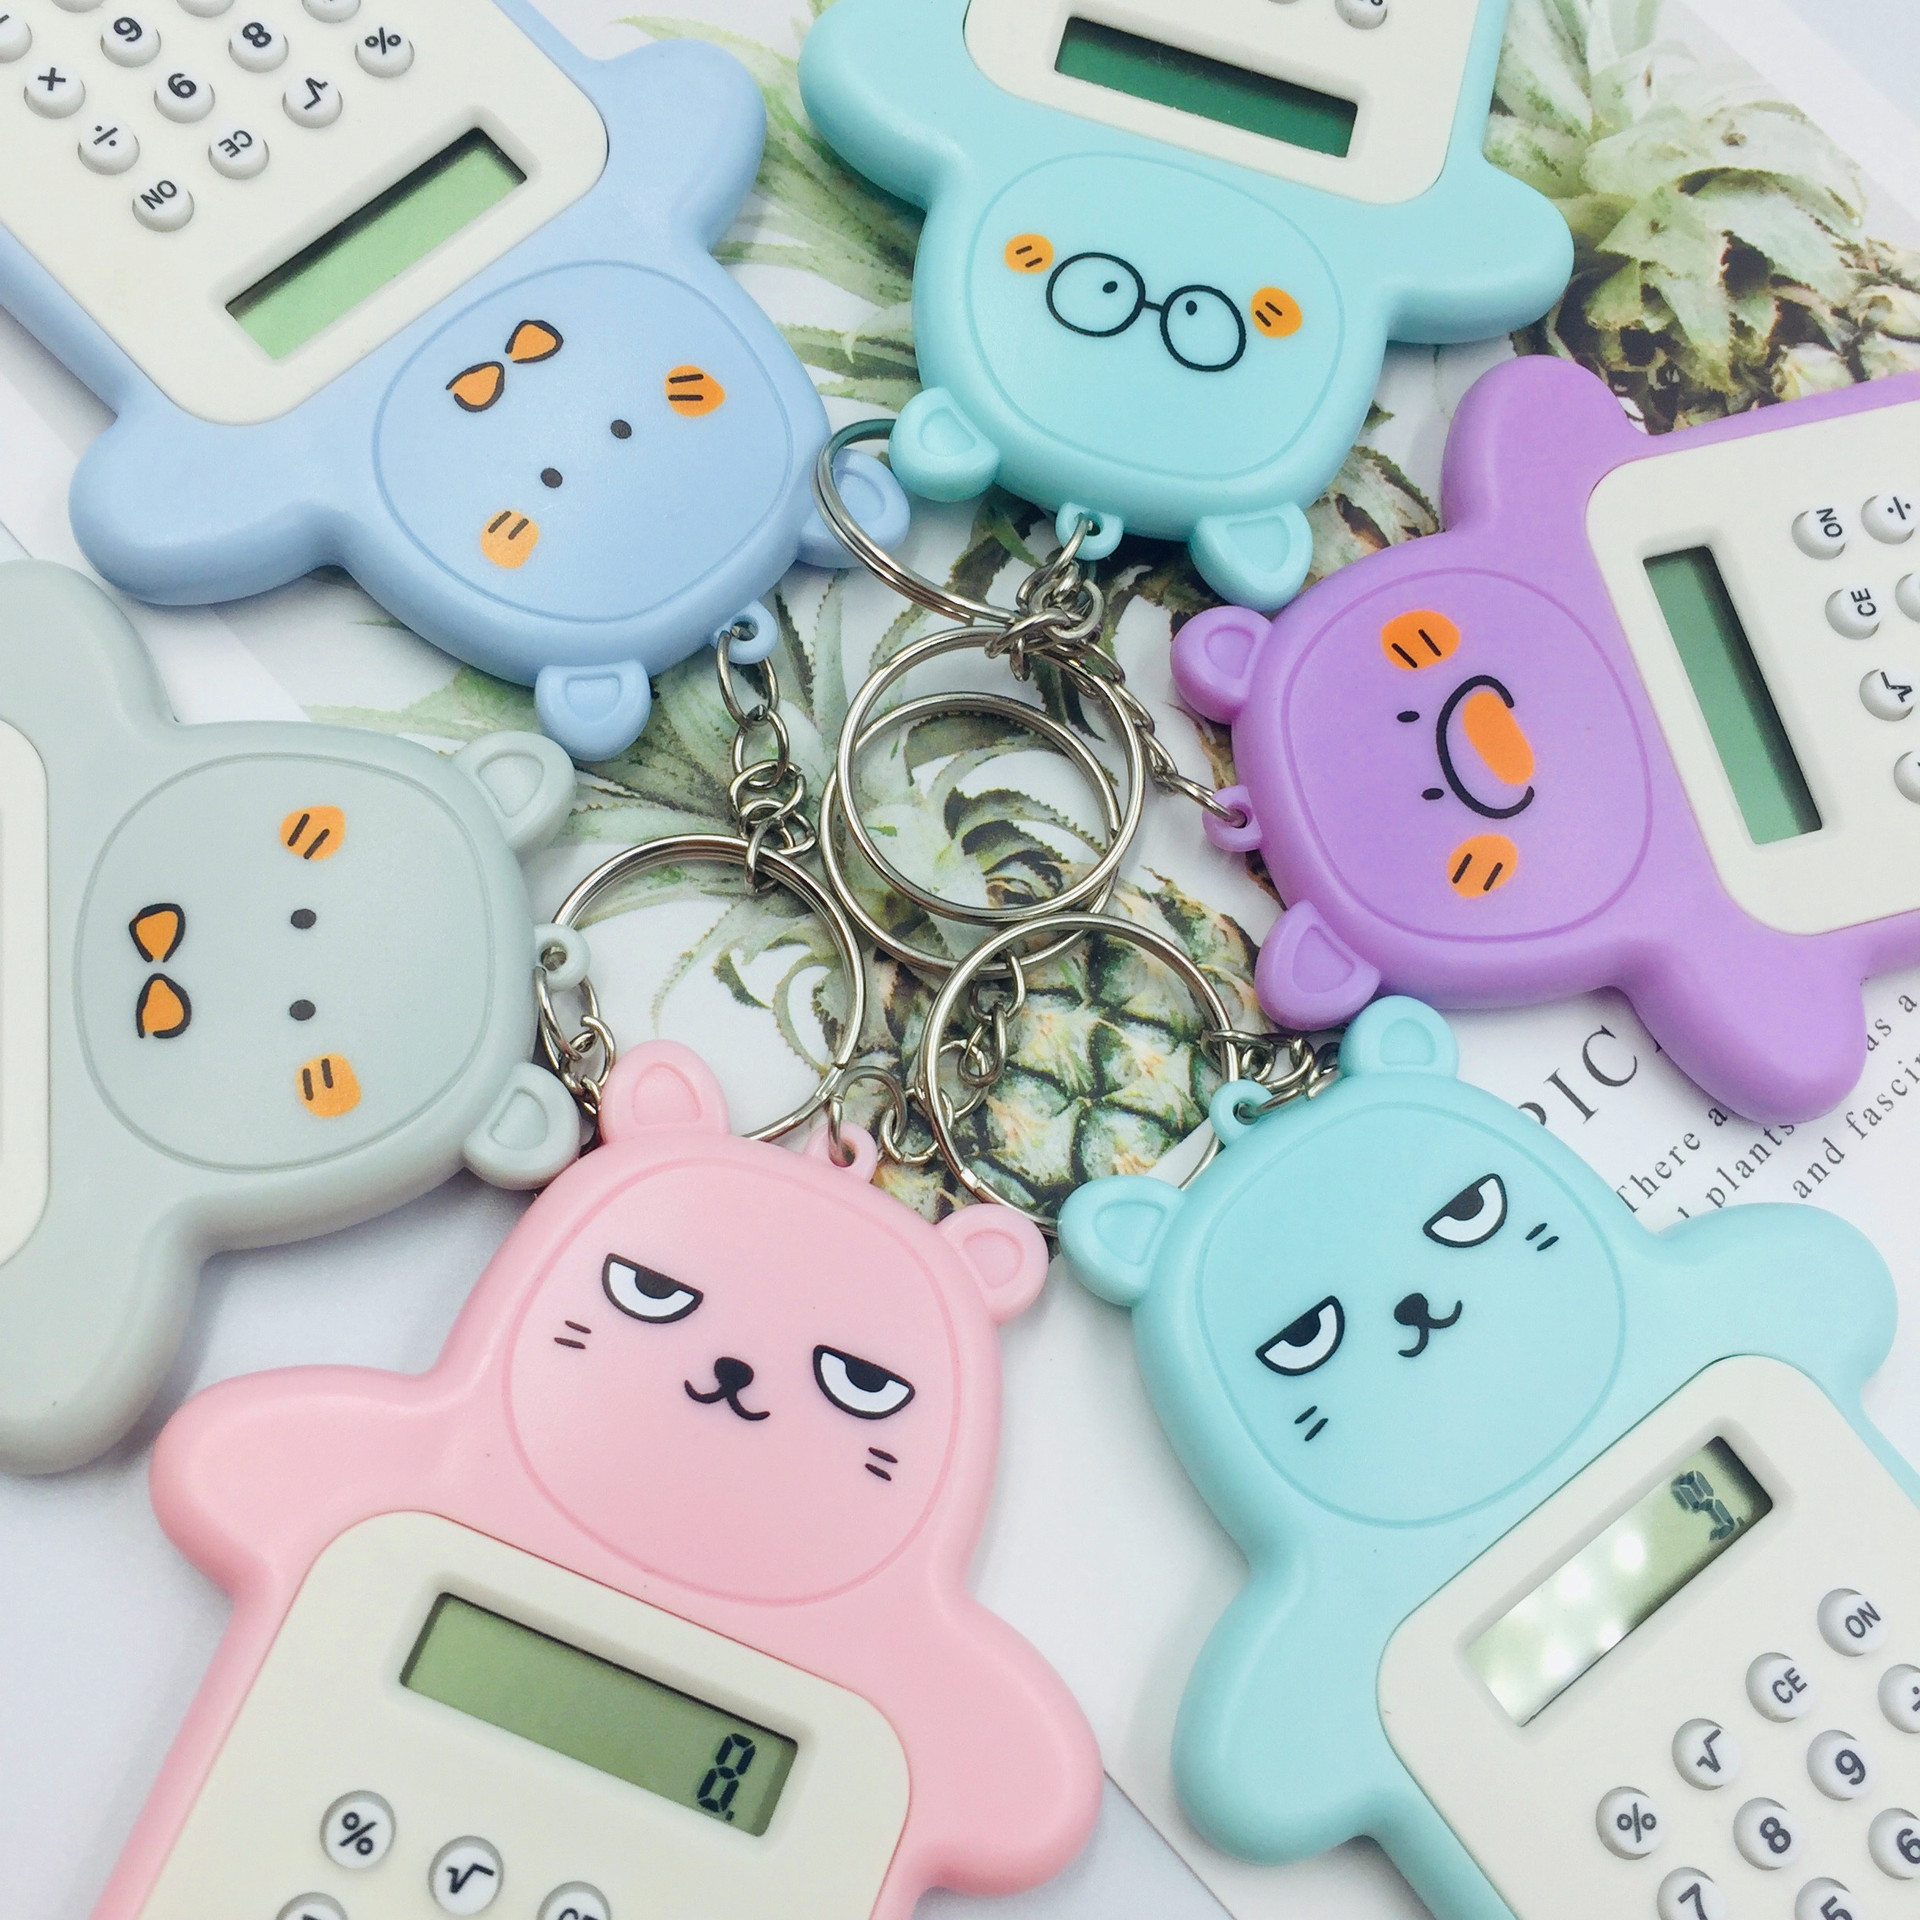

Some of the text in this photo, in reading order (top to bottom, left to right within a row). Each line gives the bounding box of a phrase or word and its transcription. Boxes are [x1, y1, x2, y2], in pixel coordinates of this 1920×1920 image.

[242, 21, 272, 48] 8
[218, 130, 253, 158] CE
[140, 179, 177, 210] ON
[1816, 507, 1843, 538] ON
[1850, 588, 1877, 617] CE
[1792, 1054, 1920, 1199] and fasci
[1616, 1132, 1700, 1213] There
[1844, 1601, 1881, 1639] ON
[1771, 1666, 1808, 1704] CE
[1835, 1749, 1866, 1786] 9
[339, 1811, 378, 1856] %
[1616, 1802, 1657, 1844] %
[1759, 1816, 1792, 1854] 8
[1896, 1828, 1920, 1865] 6
[1678, 1882, 1708, 1920] 7
